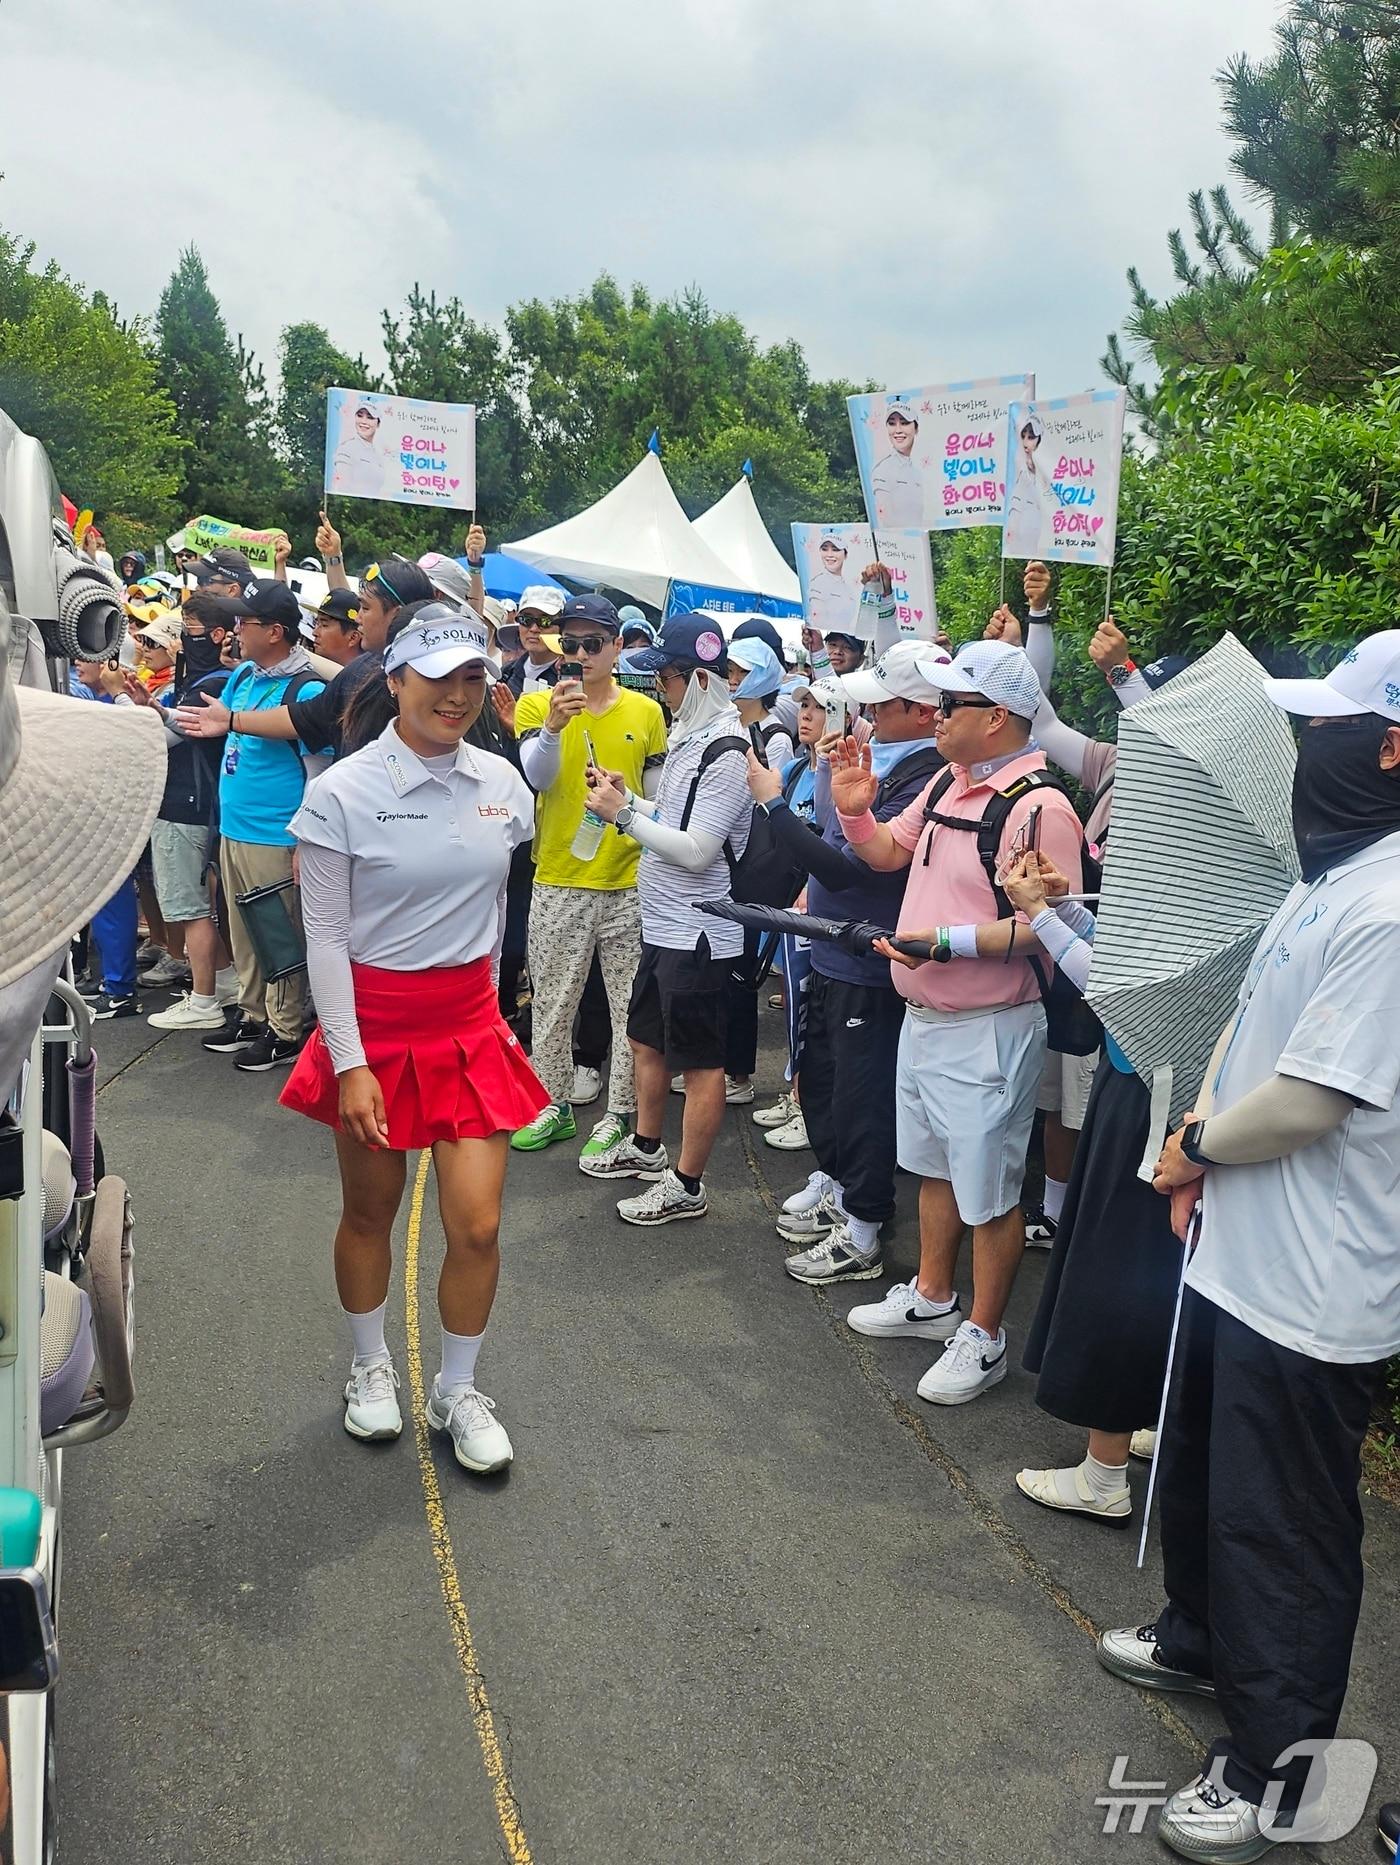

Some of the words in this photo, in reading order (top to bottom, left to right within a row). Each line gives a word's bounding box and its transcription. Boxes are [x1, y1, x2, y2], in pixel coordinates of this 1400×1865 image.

[401, 435, 447, 453] 윤이나
[944, 432, 995, 456] 윤이나
[400, 453, 447, 471] 빛이나
[944, 457, 996, 481] 빛이나
[1053, 455, 1095, 479] 윤이나
[400, 472, 446, 491] 화이팅
[942, 481, 996, 505] 화이팅
[302, 805, 328, 823] orMade
[376, 811, 429, 823] TaylorMade
